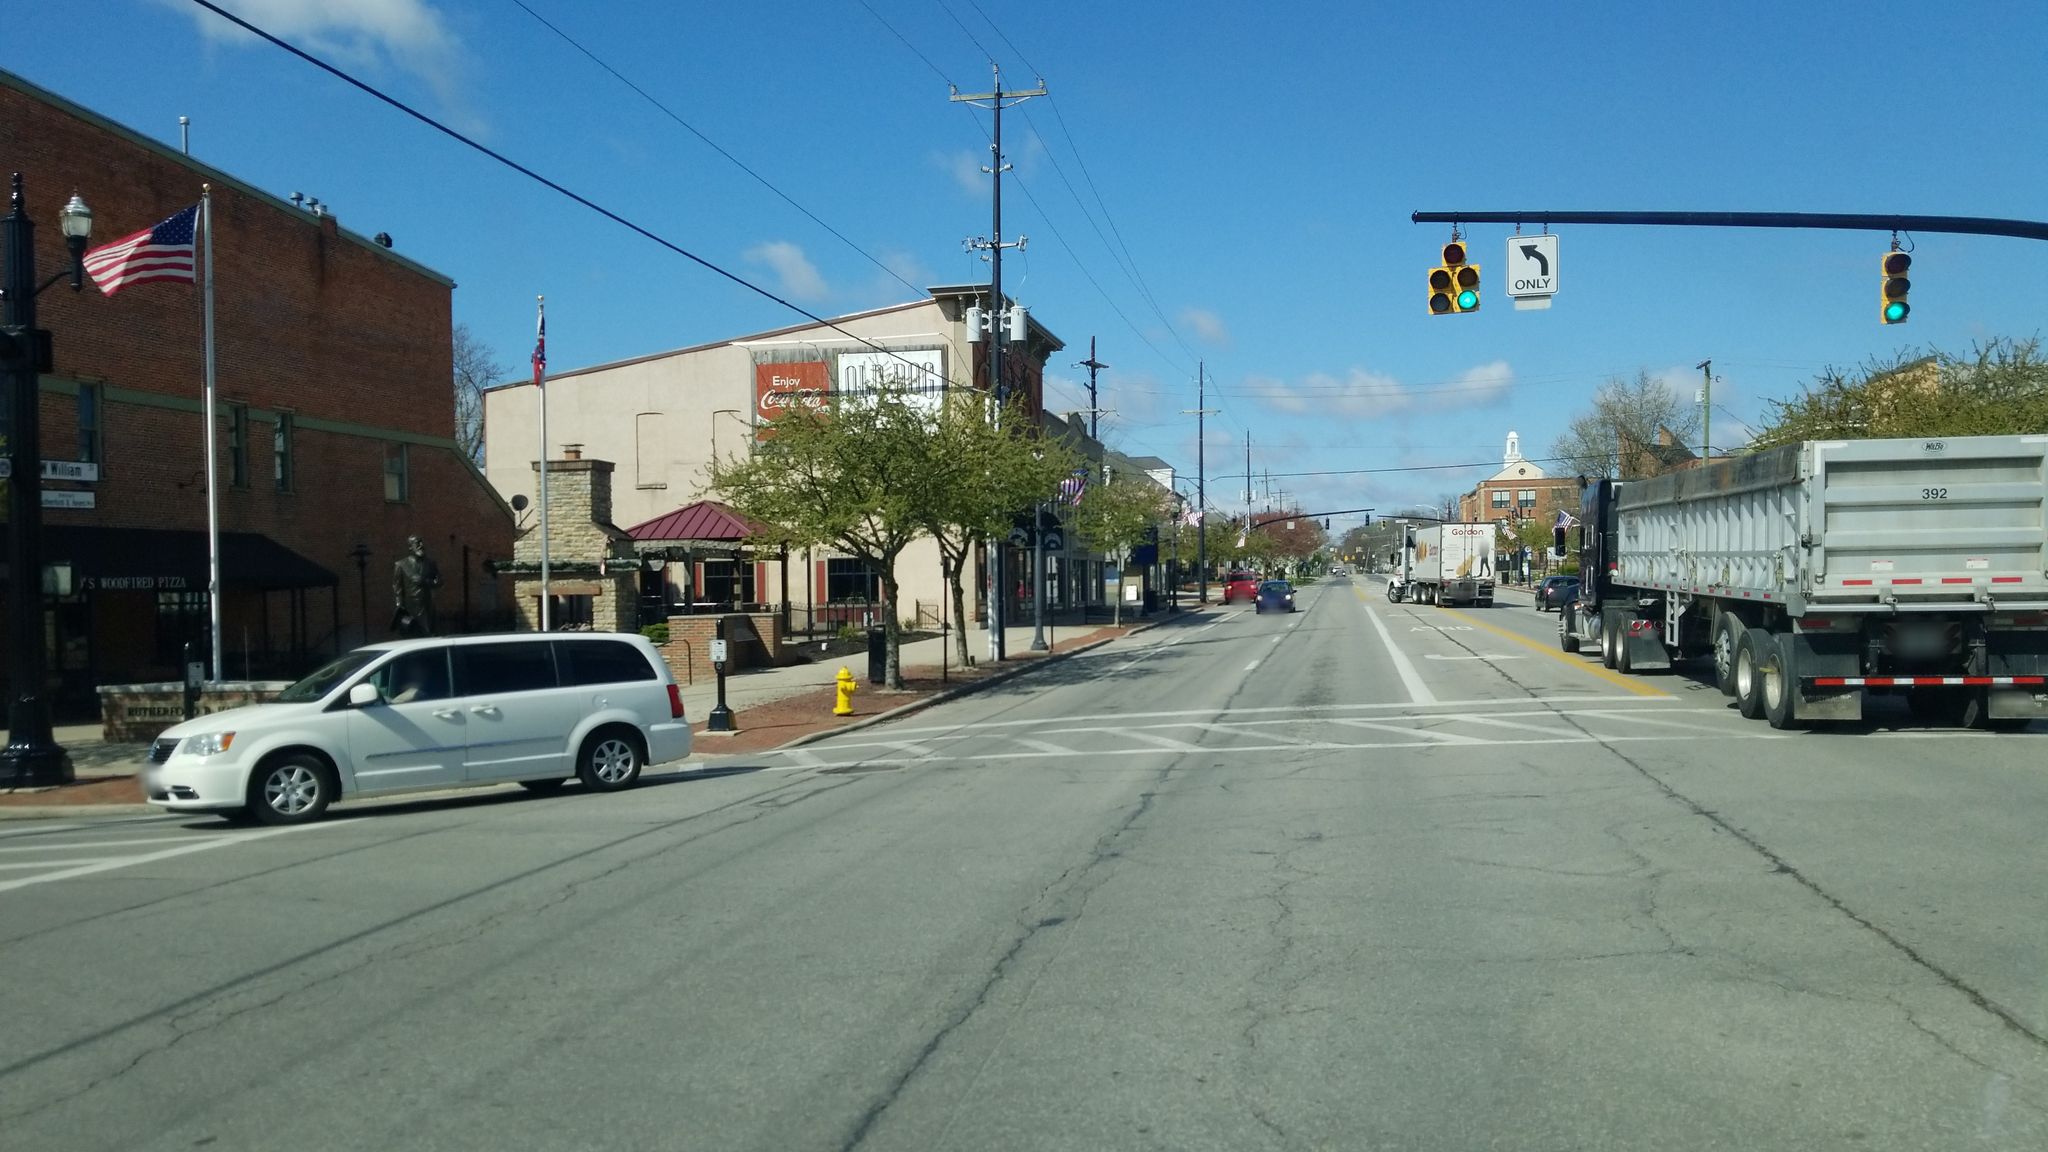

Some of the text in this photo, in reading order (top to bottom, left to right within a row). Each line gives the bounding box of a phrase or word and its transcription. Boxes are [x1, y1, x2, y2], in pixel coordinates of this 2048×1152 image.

[1515, 278, 1551, 290] ONLY
[772, 375, 801, 388] Enjoy
[51, 463, 82, 477] William
[1922, 488, 1948, 499] 392
[1451, 528, 1484, 536] Gordon
[101, 577, 154, 589] WOODFIRED
[158, 577, 186, 588] PIZZA
